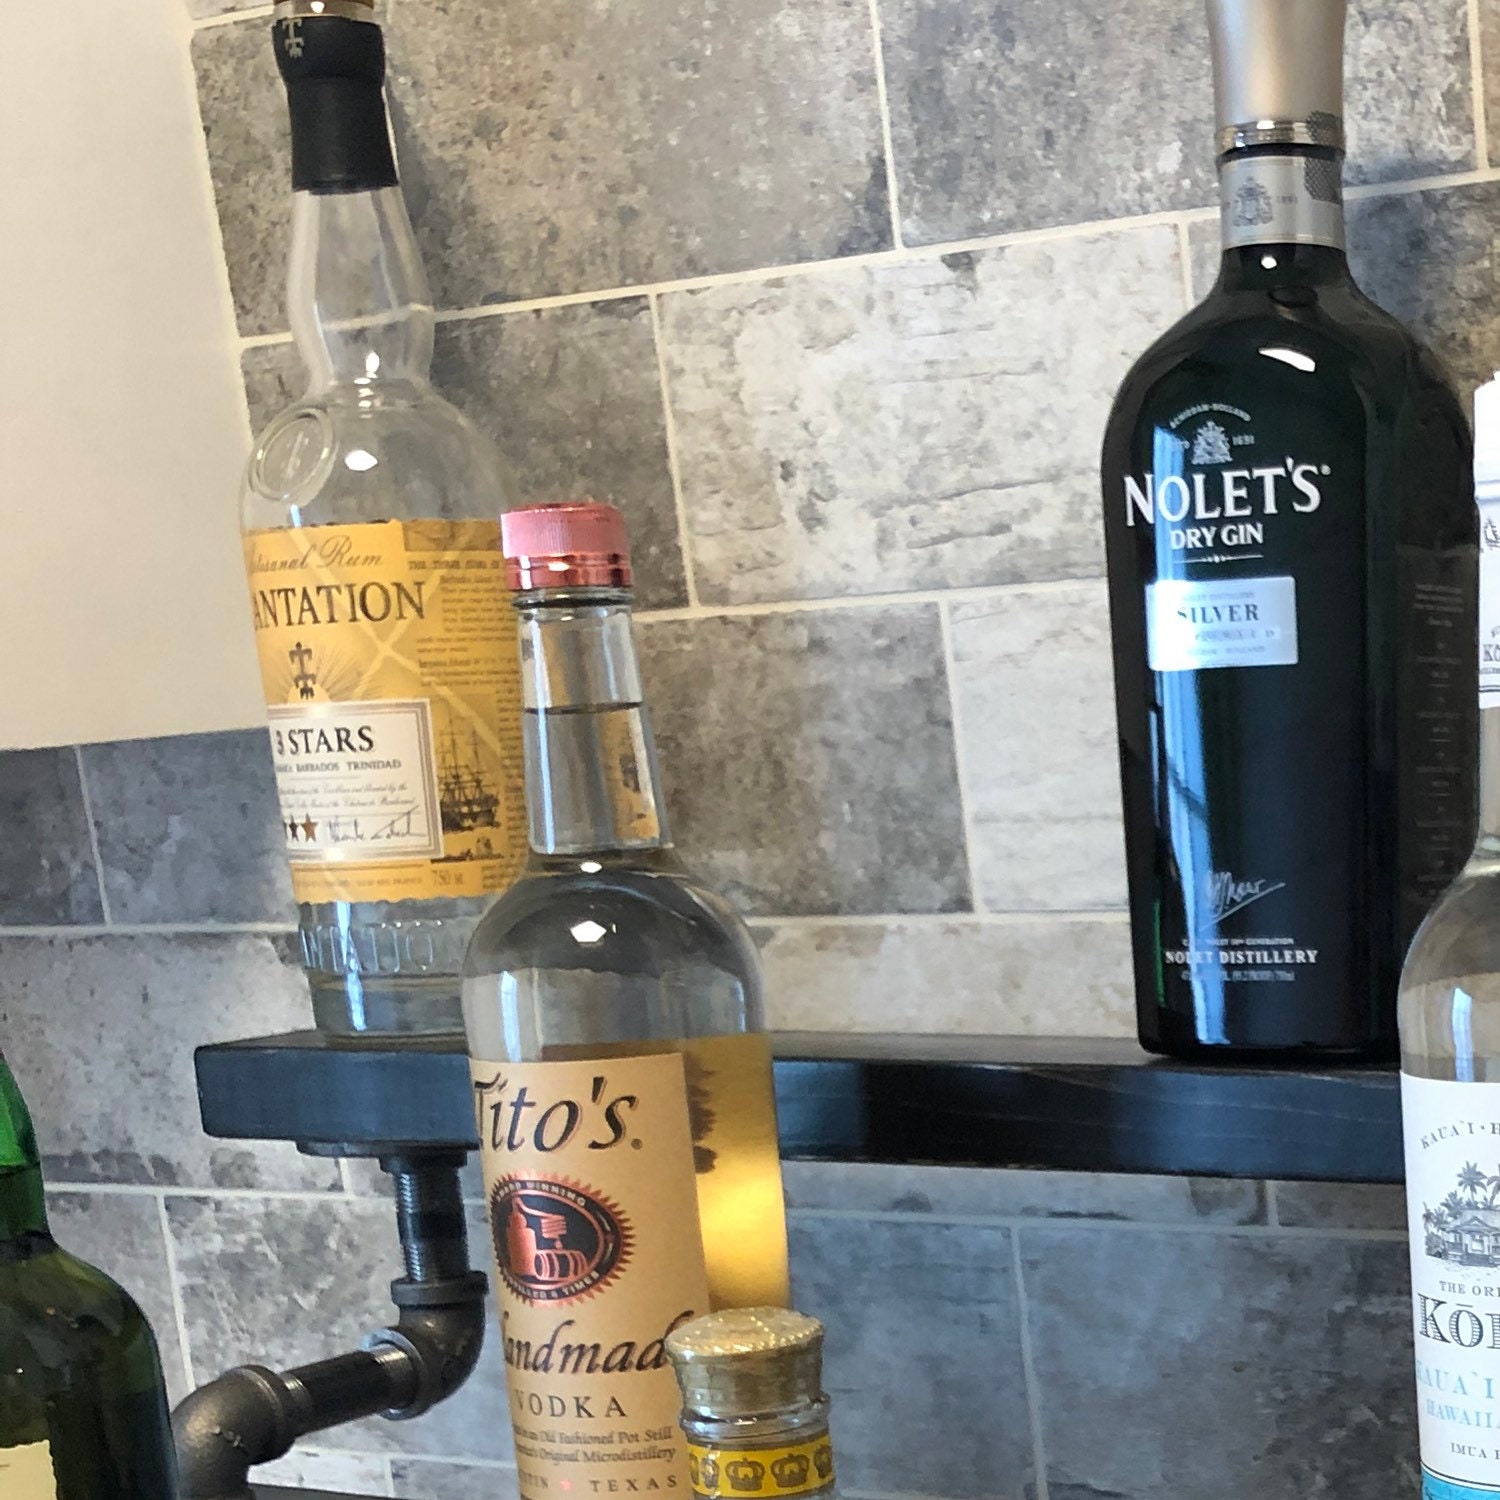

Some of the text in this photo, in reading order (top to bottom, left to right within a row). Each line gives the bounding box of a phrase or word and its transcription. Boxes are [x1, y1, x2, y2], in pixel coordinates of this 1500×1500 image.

[1123, 455, 1323, 527] NOLET'S
[1170, 522, 1265, 550] DRY GIN
[317, 534, 384, 568] Rum
[1177, 602, 1260, 625] SILVER
[275, 725, 375, 756] 3 STARS
[346, 758, 402, 771] TRINIDAD
[1219, 949, 1319, 965] DISTILLERY
[473, 1072, 640, 1154] Tito's
[525, 1180, 587, 1207] WINNING
[560, 1270, 600, 1297] TIMES
[1438, 1280, 1467, 1295] THE
[514, 1388, 630, 1419] VODKA
[559, 1429, 615, 1446] Fashioned
[618, 1431, 640, 1444] Pot
[643, 1425, 675, 1442] Still
[581, 1445, 677, 1463] Microdistillery
[1450, 1442, 1488, 1460] IMUA
[587, 1474, 679, 1494] TEXAS
